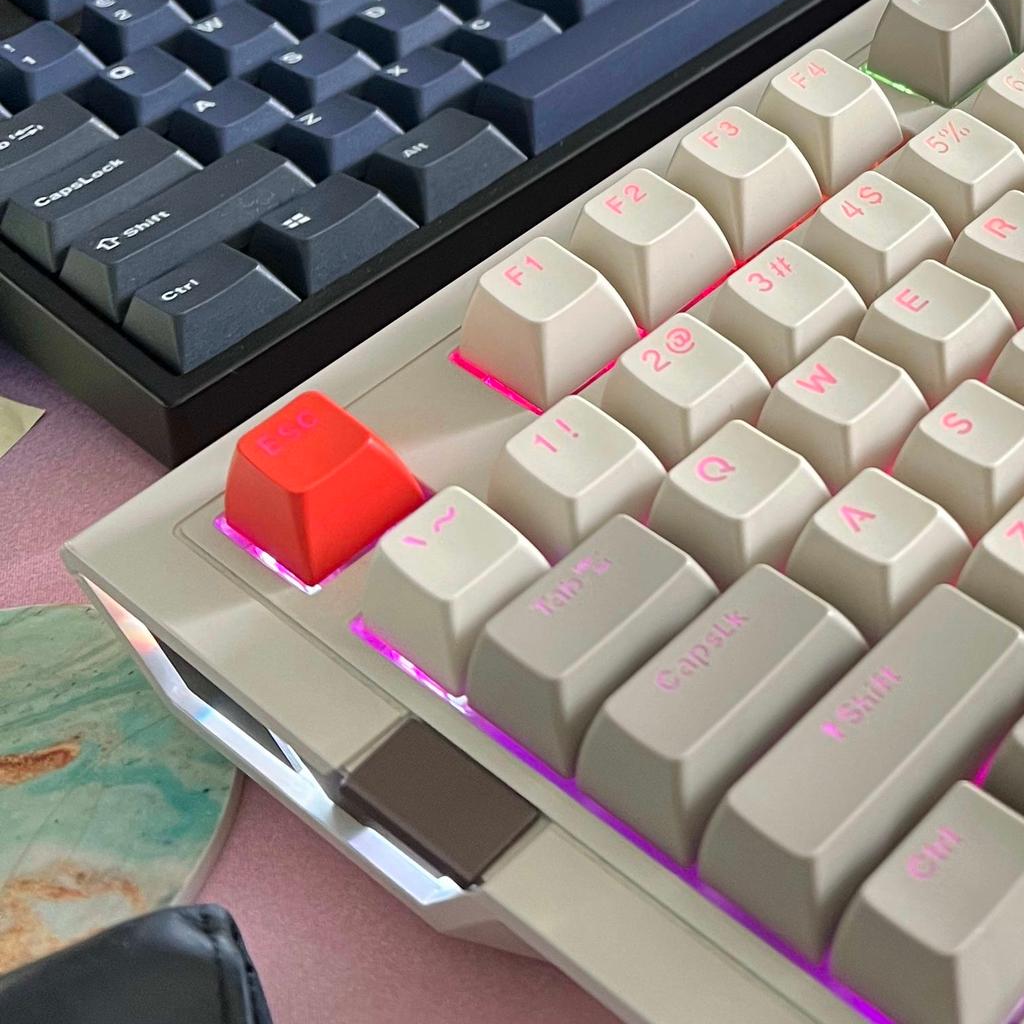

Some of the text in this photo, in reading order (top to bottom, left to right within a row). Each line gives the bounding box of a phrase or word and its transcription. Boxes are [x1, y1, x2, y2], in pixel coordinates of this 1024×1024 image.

[789, 61, 828, 90] F4
[194, 100, 217, 113] A
[299, 112, 323, 126] Z
[701, 120, 741, 149] F3
[402, 142, 430, 159] Alt
[34, 158, 125, 207] CapsLock
[604, 184, 648, 215] F2
[123, 210, 171, 238] Shift
[982, 215, 1018, 240] R
[504, 255, 544, 286] F1
[161, 279, 200, 302] Ctrl
[895, 287, 930, 313] E
[796, 362, 838, 394] W
[942, 411, 975, 436] S
[695, 455, 737, 483] Q
[839, 504, 877, 533] A
